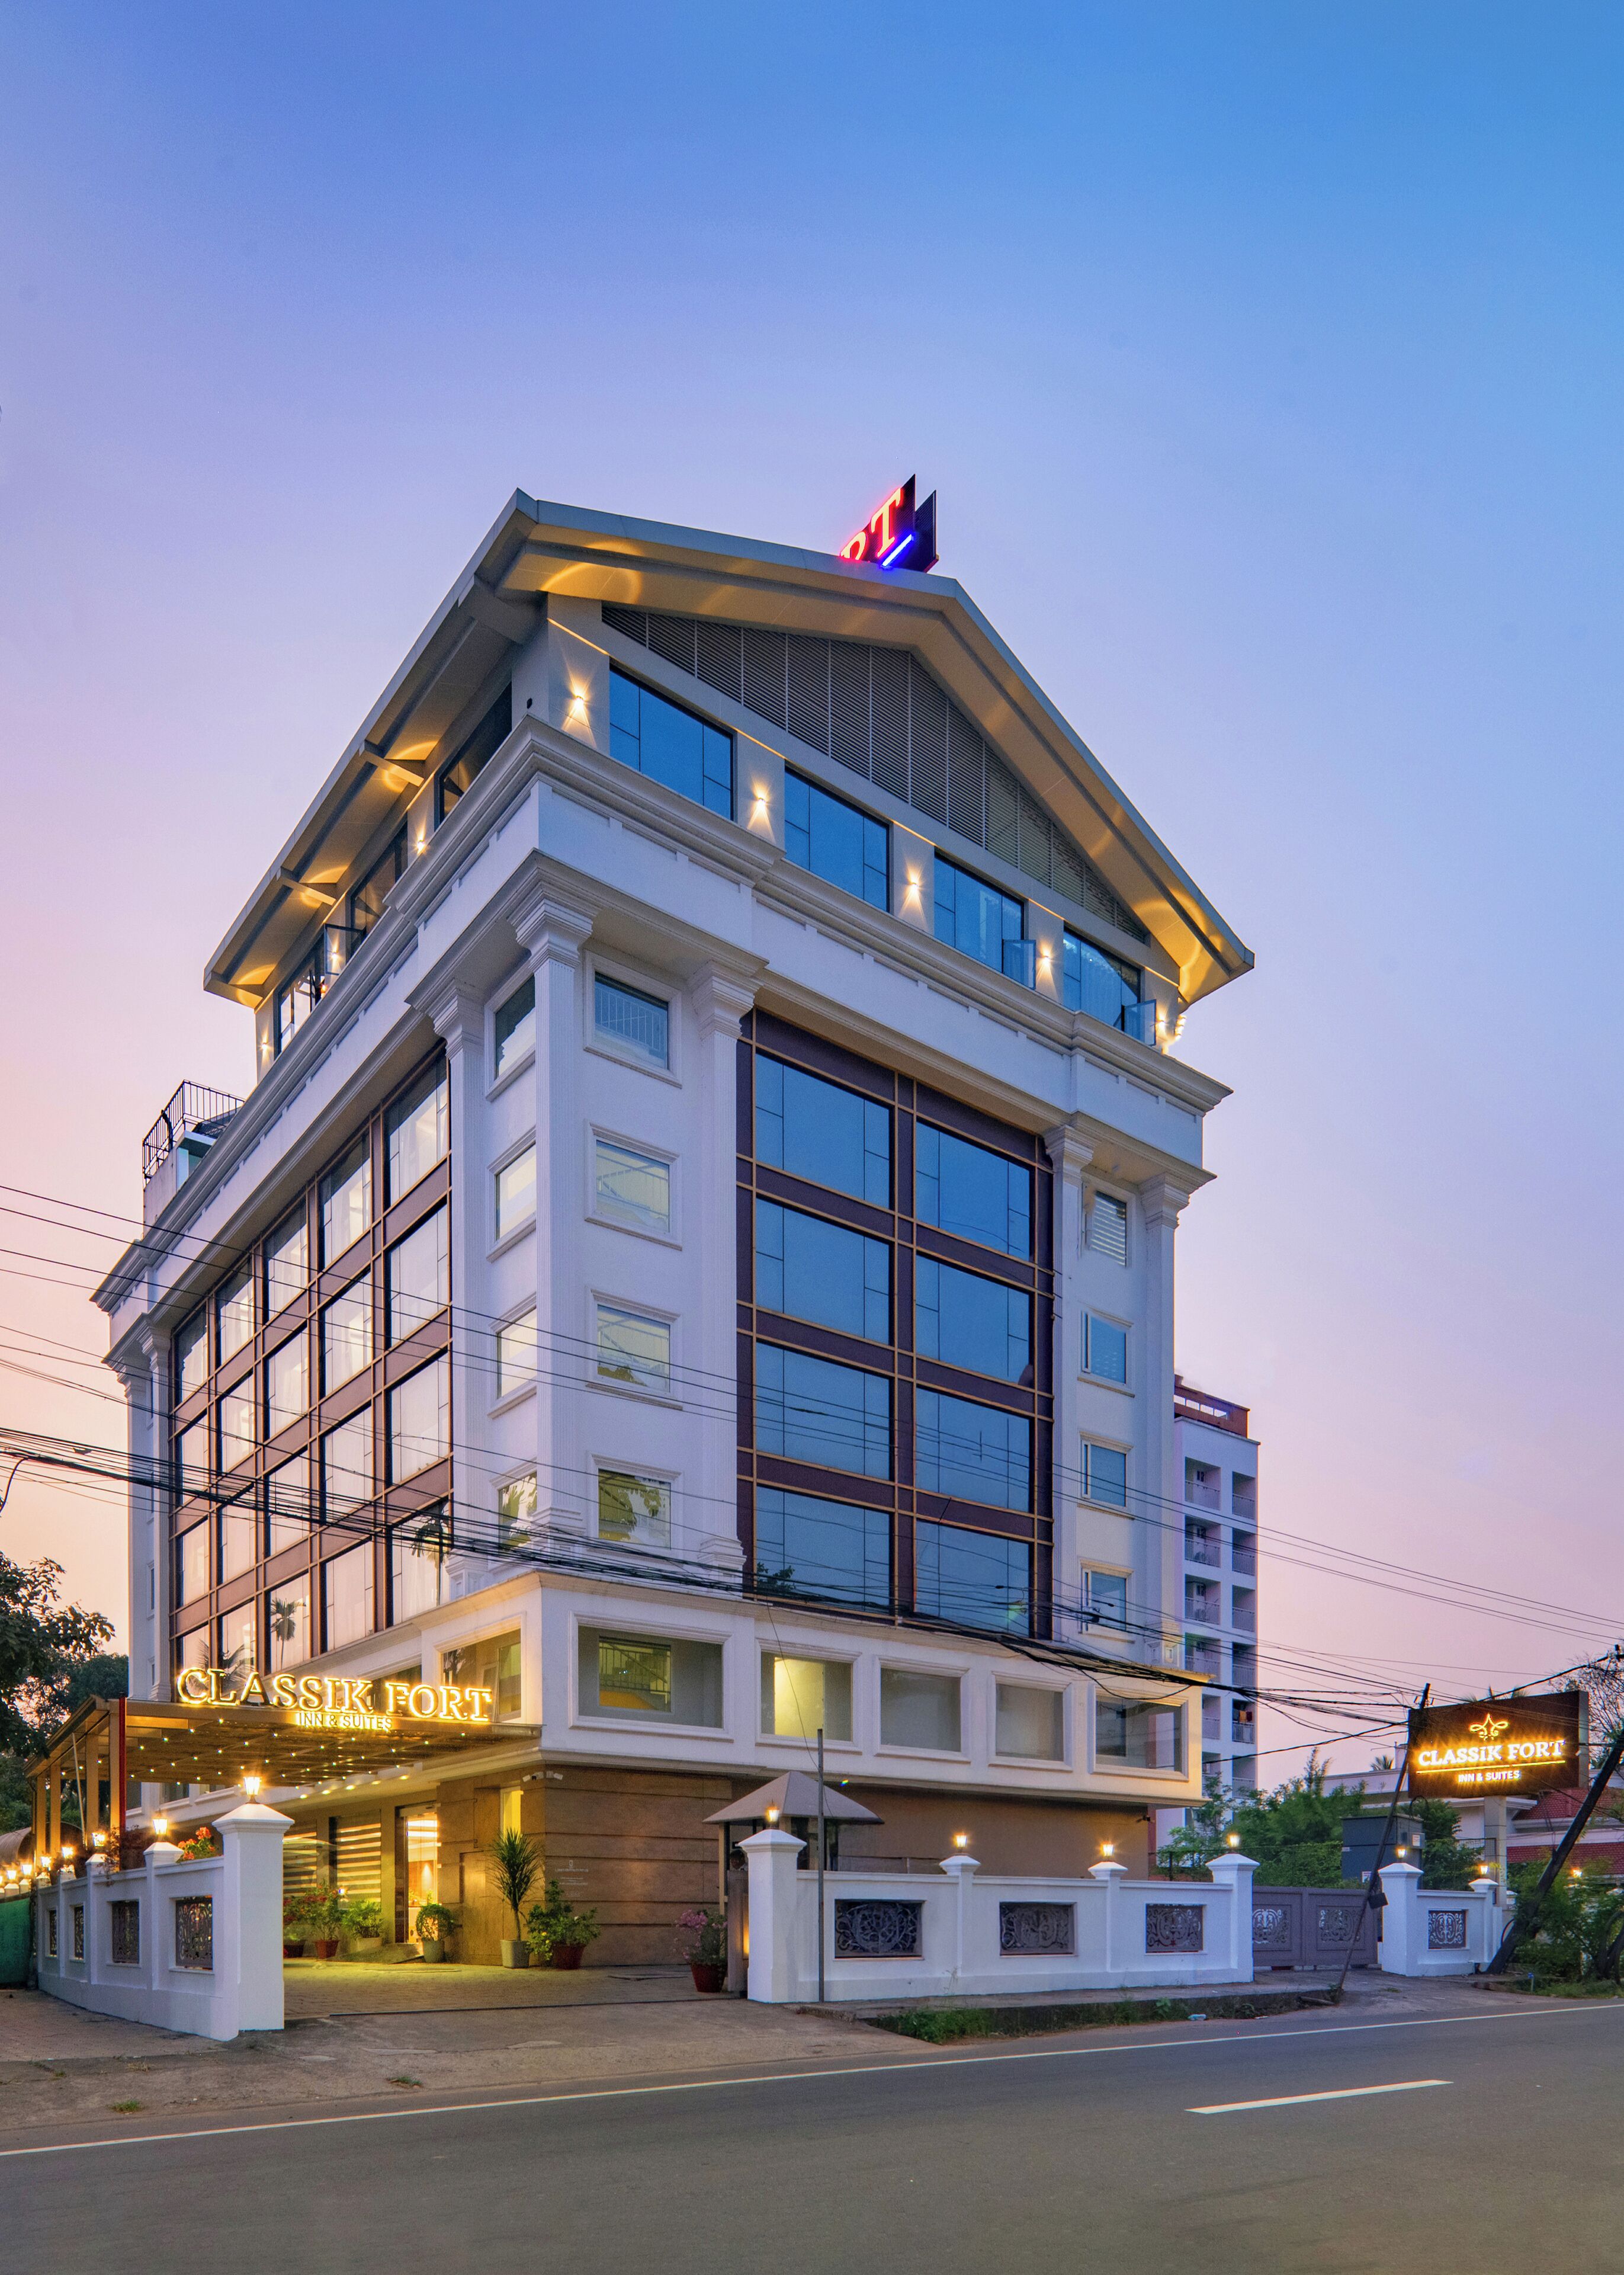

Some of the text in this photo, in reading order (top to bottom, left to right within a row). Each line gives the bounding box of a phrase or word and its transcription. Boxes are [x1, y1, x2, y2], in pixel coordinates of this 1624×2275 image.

[176, 1667, 492, 1722] CLASSIK FORT
[299, 1712, 393, 1729] INN & SUITES
[1507, 1739, 1565, 1760] FORT
[1458, 1770, 1520, 1782] INN & SUITES
